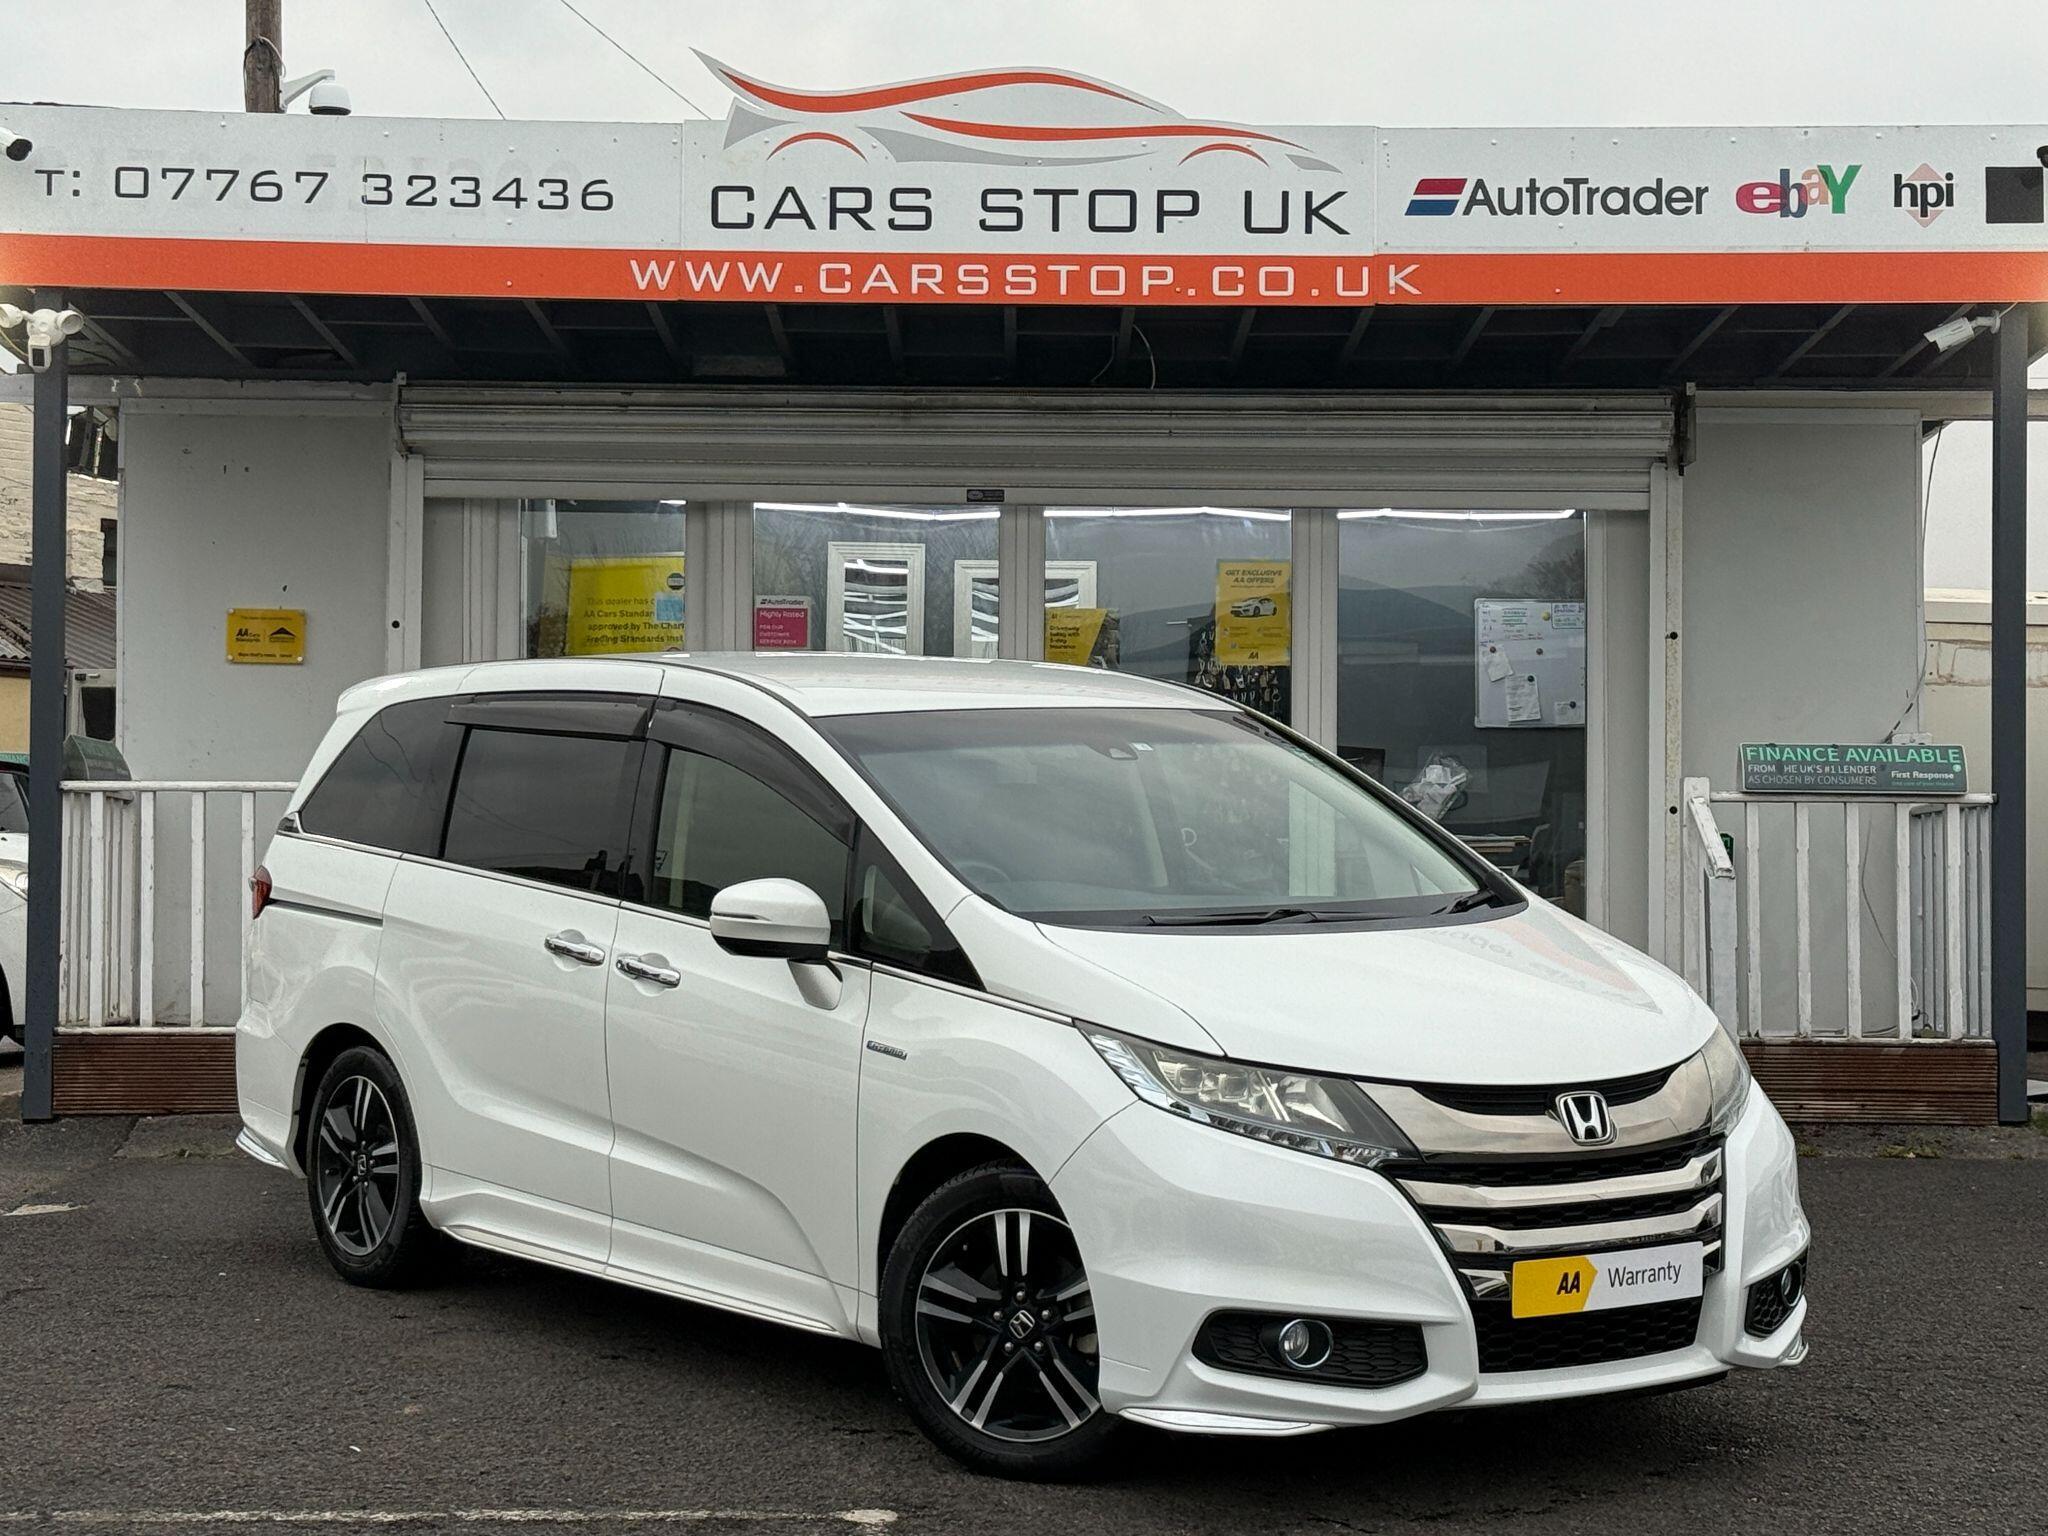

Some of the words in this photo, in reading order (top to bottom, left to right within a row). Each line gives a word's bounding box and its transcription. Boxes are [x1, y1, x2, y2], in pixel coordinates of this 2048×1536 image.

[34, 168, 82, 199] T:
[114, 166, 330, 204] 07767
[362, 173, 615, 212] 323436
[1462, 177, 1710, 217] AutoTrader
[1894, 172, 1956, 219] hpi
[711, 185, 934, 232] CARS
[979, 188, 1201, 235] STOP
[1245, 190, 1351, 236] UK
[630, 259, 1423, 299] WWW.CARSSTOP.CO.UK
[1746, 747, 1840, 762] FINANCE
[1845, 748, 1962, 764] AVAILABLE
[1748, 764, 1776, 773] FROM
[1800, 764, 1822, 774] UK'S
[1838, 765, 1877, 775] LENDER
[1748, 775, 1760, 784] AS
[1761, 775, 1801, 785] CHOSEN
[1804, 776, 1816, 785] BY
[1817, 776, 1878, 786] CONSUMERS
[1891, 770, 1910, 779] First
[1912, 770, 1955, 781] Response
[1556, 1270, 1582, 1297] AA
[1607, 1261, 1683, 1289] Warranty
